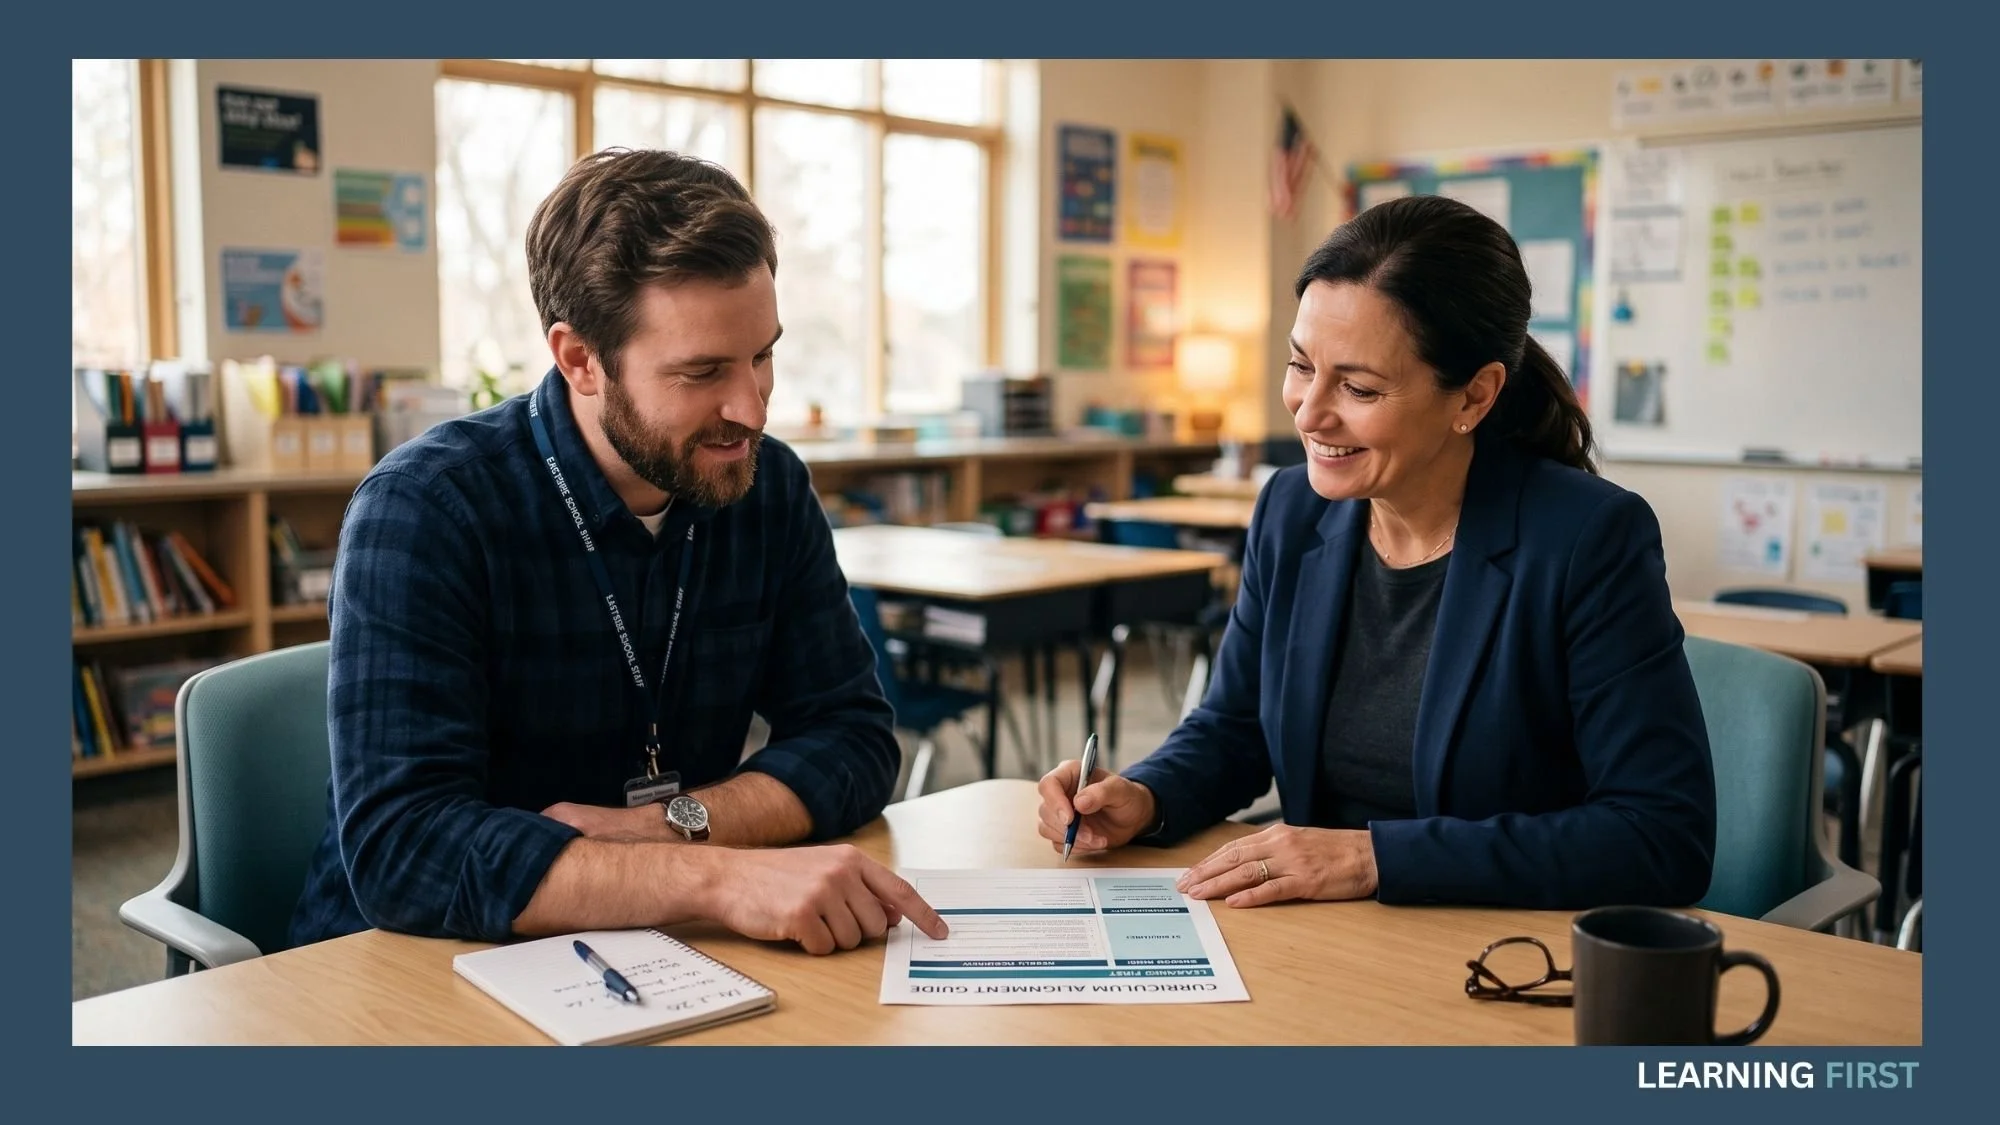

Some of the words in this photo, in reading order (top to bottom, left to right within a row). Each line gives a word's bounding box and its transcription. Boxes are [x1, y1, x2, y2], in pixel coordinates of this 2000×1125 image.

[564, 496, 585, 529] SCHOOL
[910, 985, 968, 993] GUIDE
[974, 984, 1086, 993] ALIGNMENT
[1092, 983, 1217, 992] CURRICULUM
